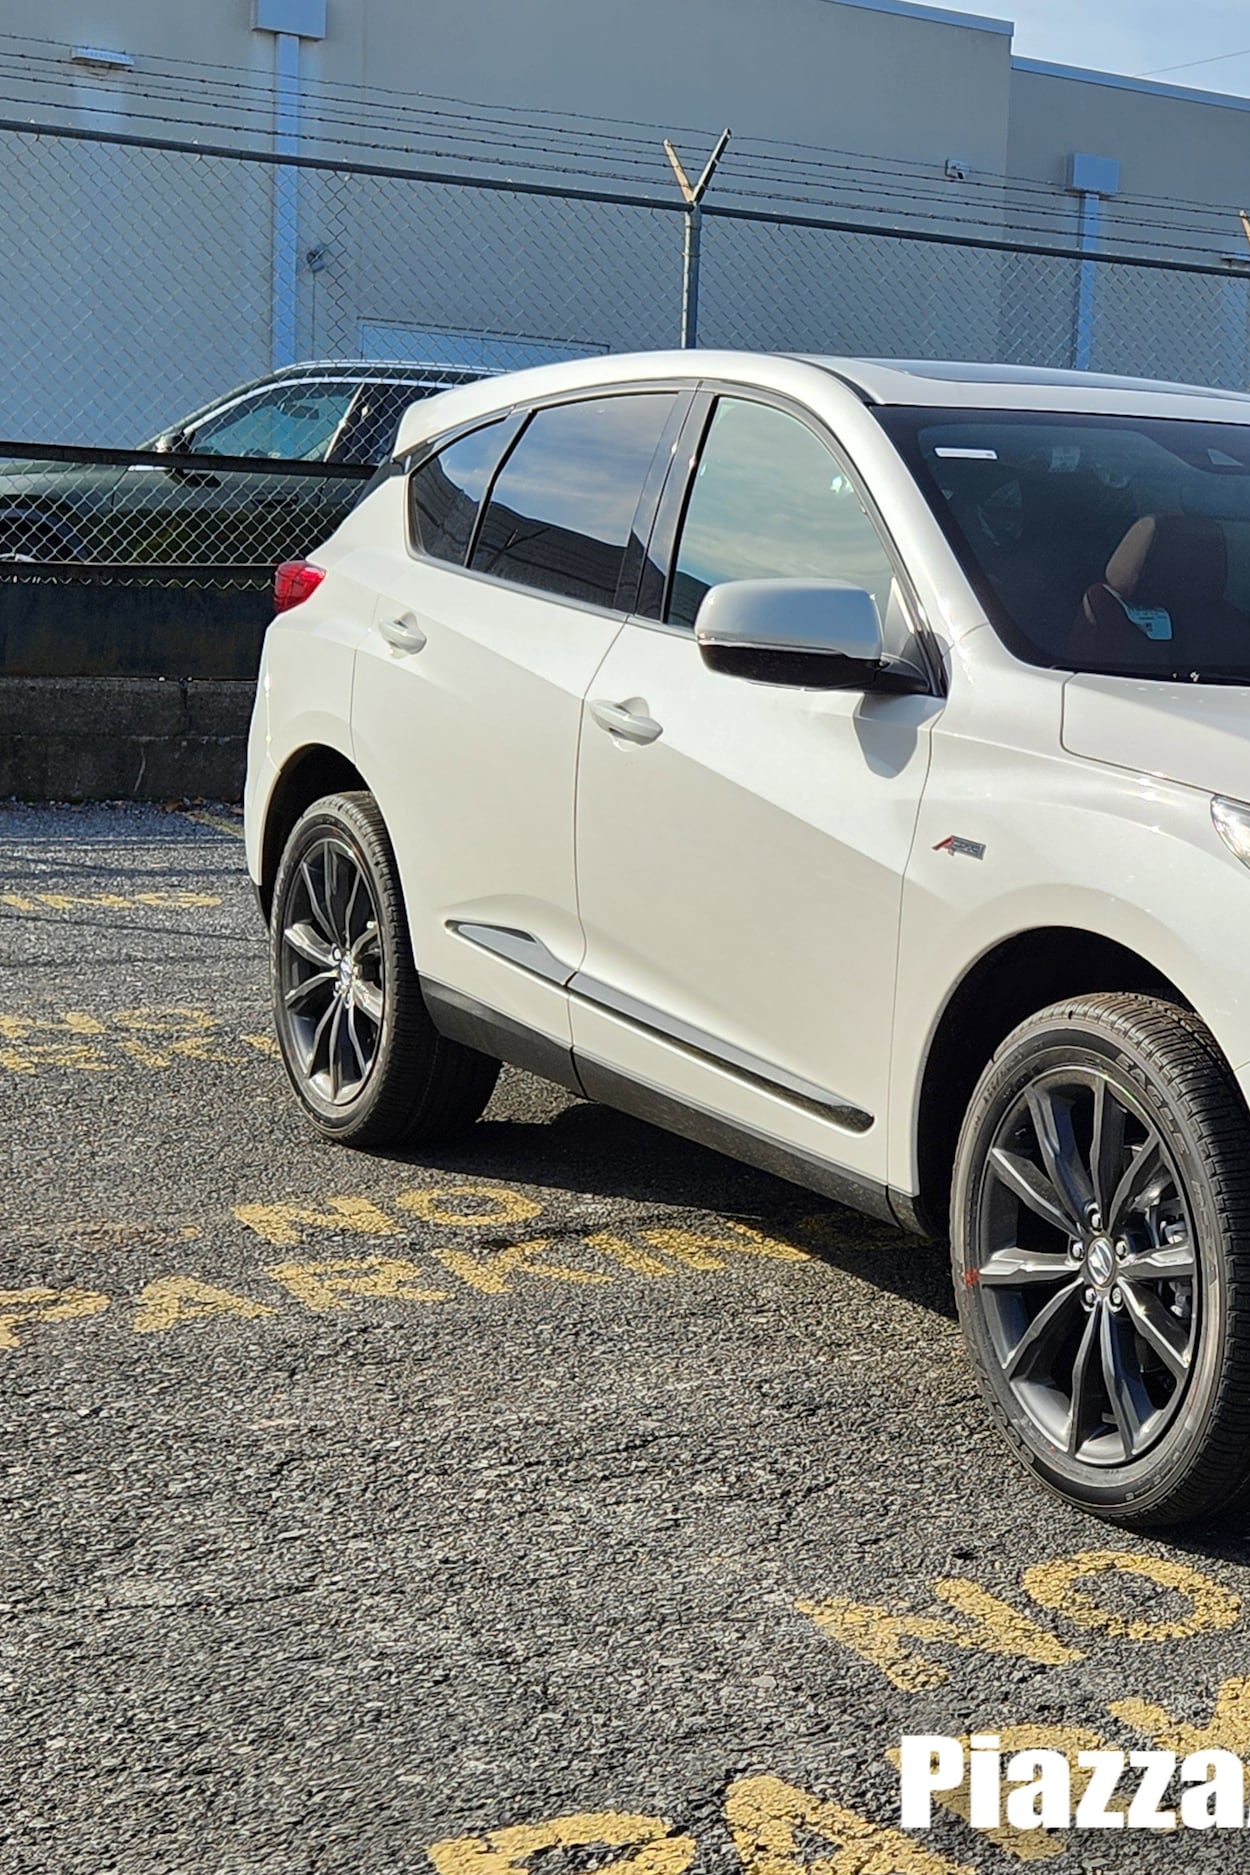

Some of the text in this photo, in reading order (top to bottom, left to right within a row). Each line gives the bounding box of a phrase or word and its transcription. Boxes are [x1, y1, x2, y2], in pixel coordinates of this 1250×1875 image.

[1115, 1053, 1190, 1154] EAGLE
[234, 1186, 544, 1245] NO
[796, 1550, 1242, 1694] NO
